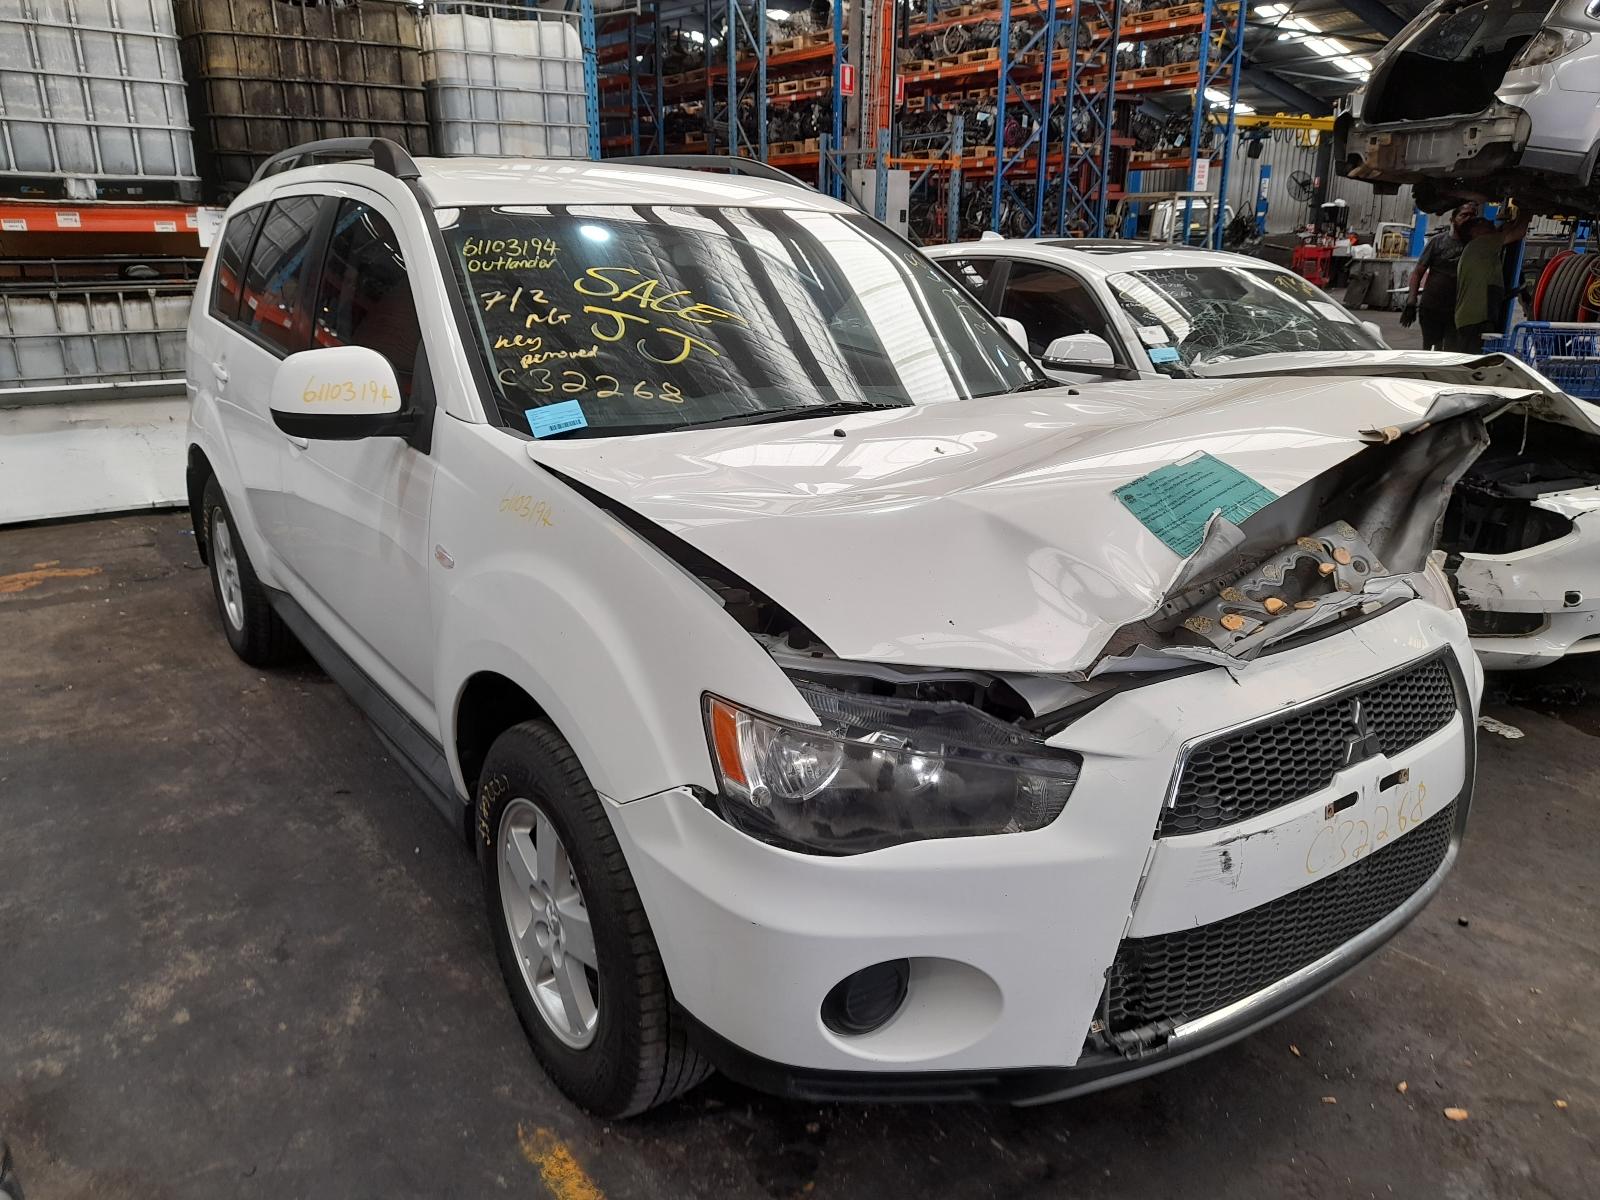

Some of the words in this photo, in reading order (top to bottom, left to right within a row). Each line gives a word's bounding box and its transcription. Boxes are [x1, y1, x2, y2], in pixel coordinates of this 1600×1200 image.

[461, 236, 561, 257] 61103194
[303, 375, 393, 406] 61103194
[498, 367, 685, 404] C32268
[1305, 782, 1426, 875] C32268
